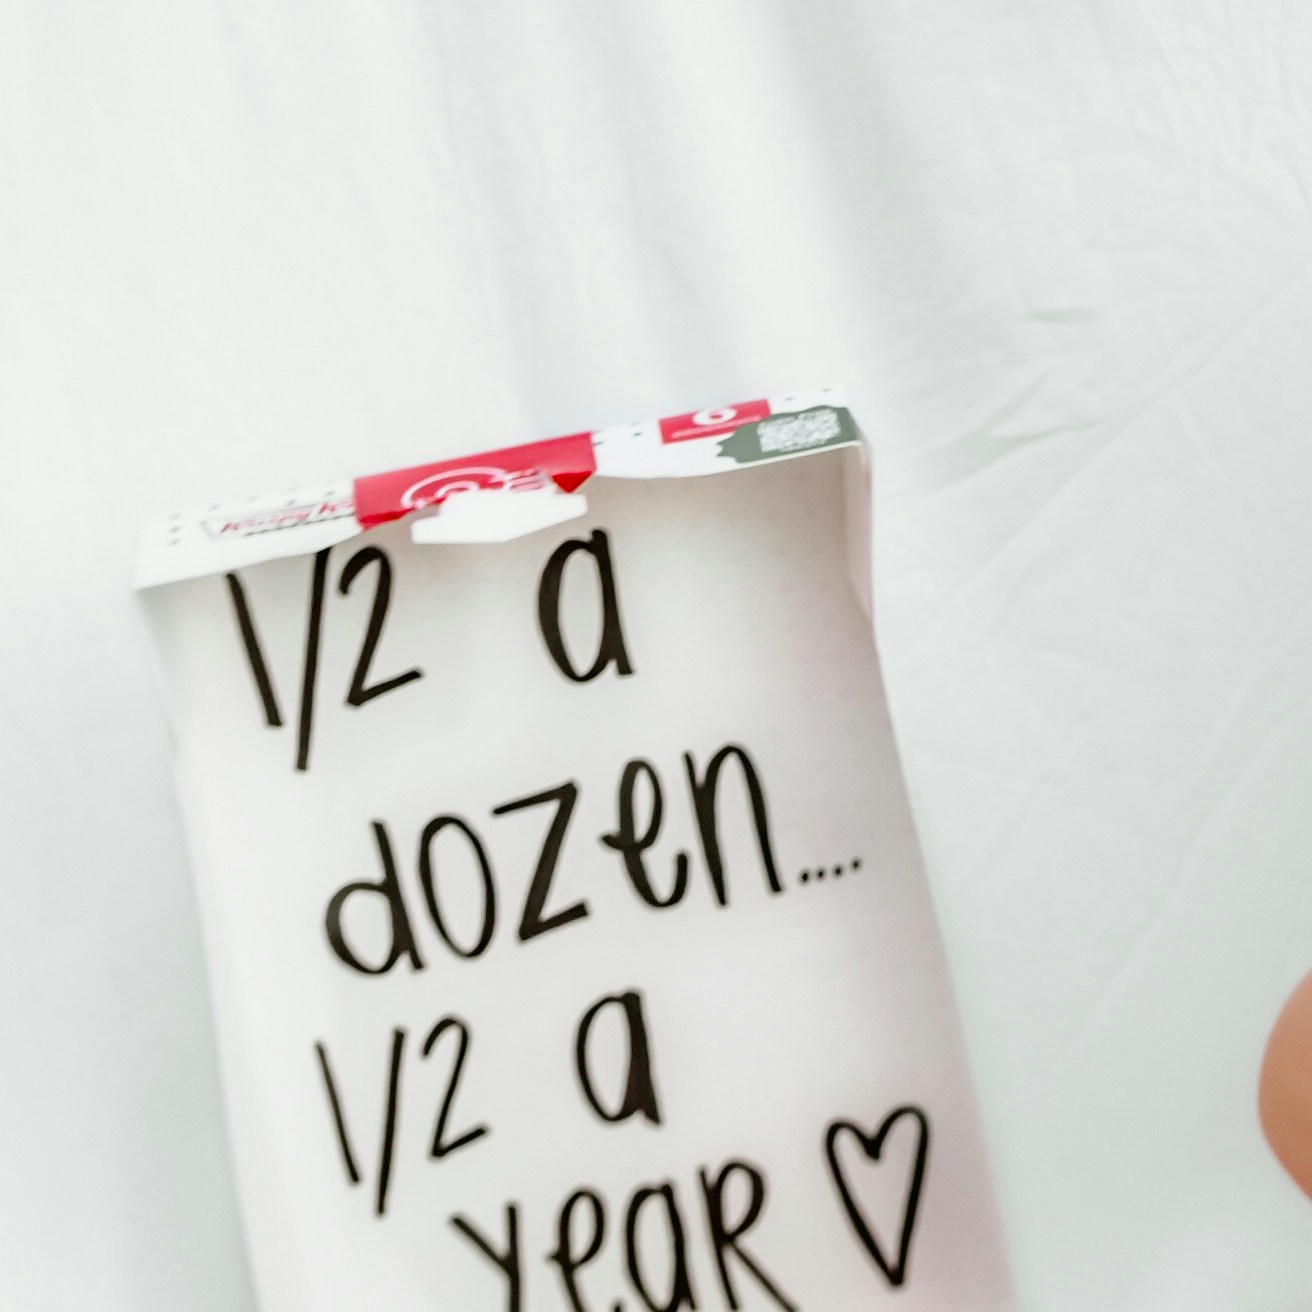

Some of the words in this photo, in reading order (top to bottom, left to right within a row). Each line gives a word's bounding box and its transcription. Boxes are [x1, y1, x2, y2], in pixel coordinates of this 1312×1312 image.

[224, 544, 423, 771] 1/2
[536, 527, 635, 684] a
[315, 1016, 489, 1216] 1/2
[574, 989, 662, 1126] a
